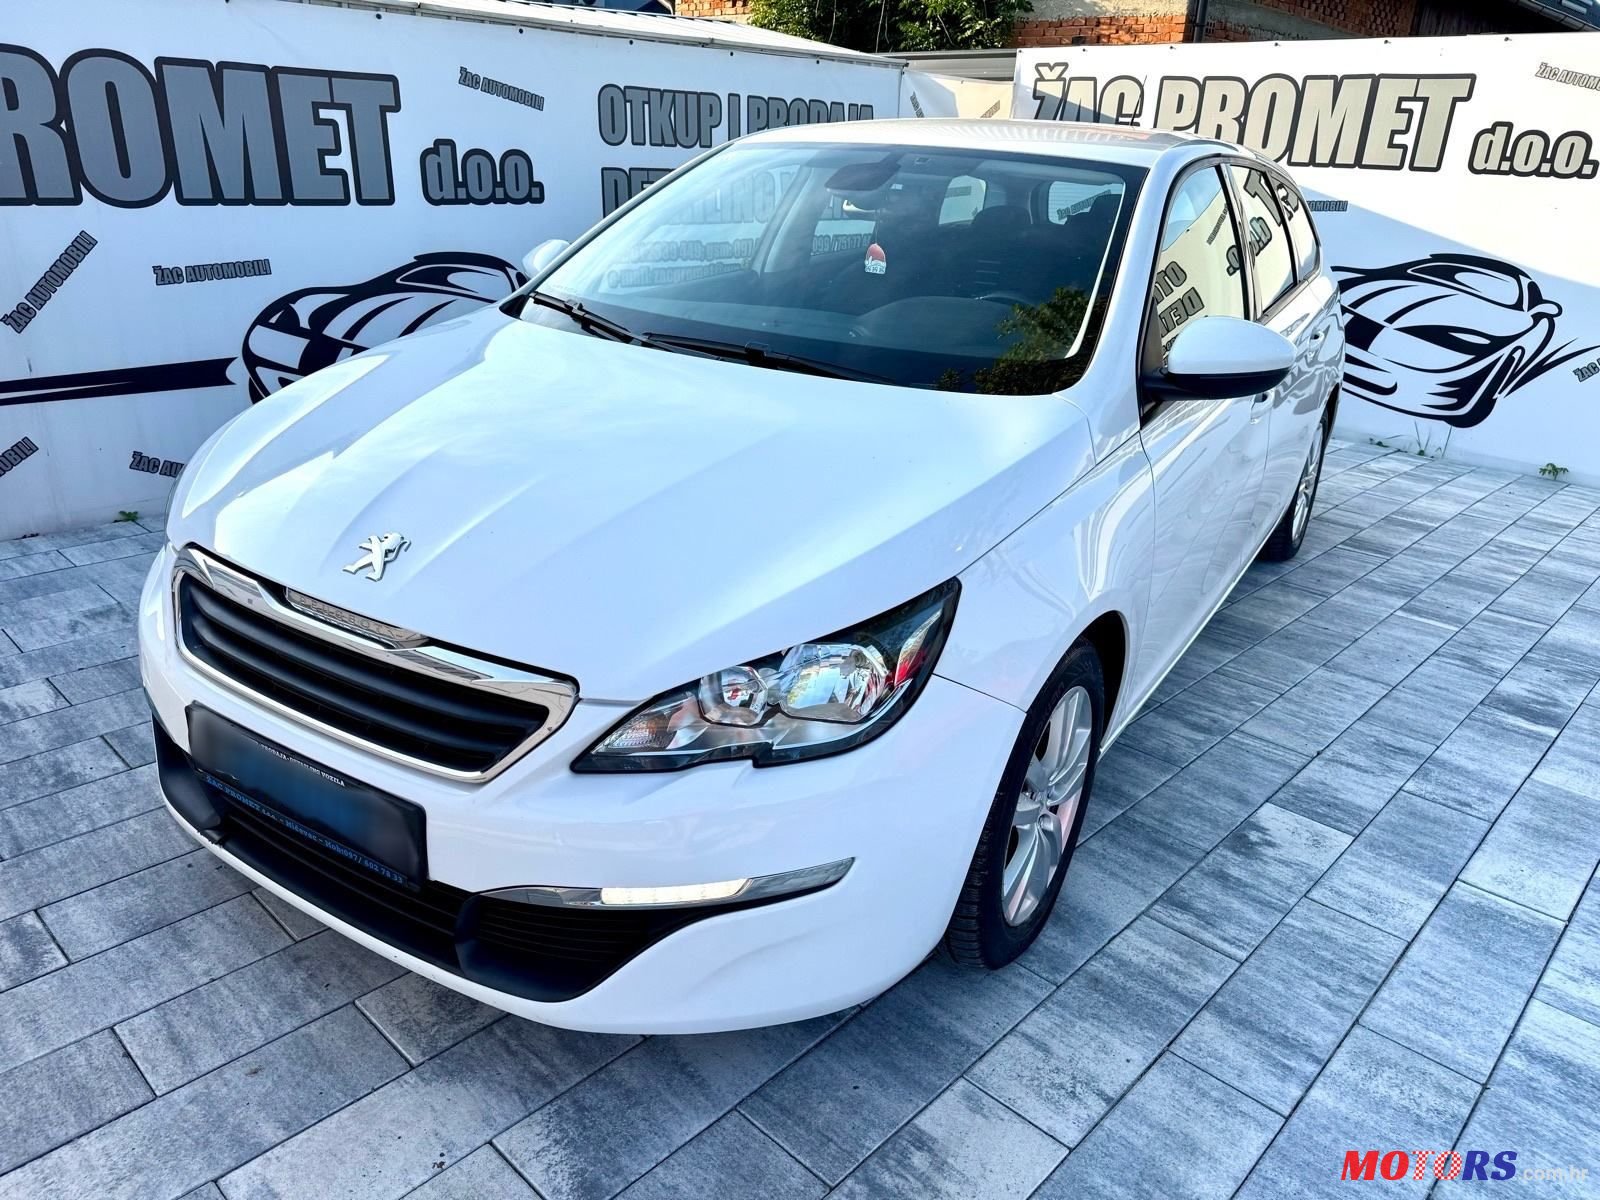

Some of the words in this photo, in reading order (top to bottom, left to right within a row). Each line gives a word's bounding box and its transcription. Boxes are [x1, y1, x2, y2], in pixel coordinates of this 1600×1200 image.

[459, 66, 481, 90] ŽAC
[480, 76, 545, 111] AUTOMOBILI
[1535, 62, 1561, 81] ŽAC
[598, 83, 722, 148] OTKUP
[1153, 73, 1477, 172] PROMET
[1468, 121, 1600, 179] d.o.o.
[420, 139, 545, 205] d.o.o.
[0, 302, 37, 334] ŽAC
[25, 230, 98, 311] AUTOMOBILI
[152, 265, 184, 286] ŽAC
[185, 259, 272, 283] AUTOMOBILI
[129, 451, 160, 474] ŽAC
[224, 786, 260, 811] PROMET
